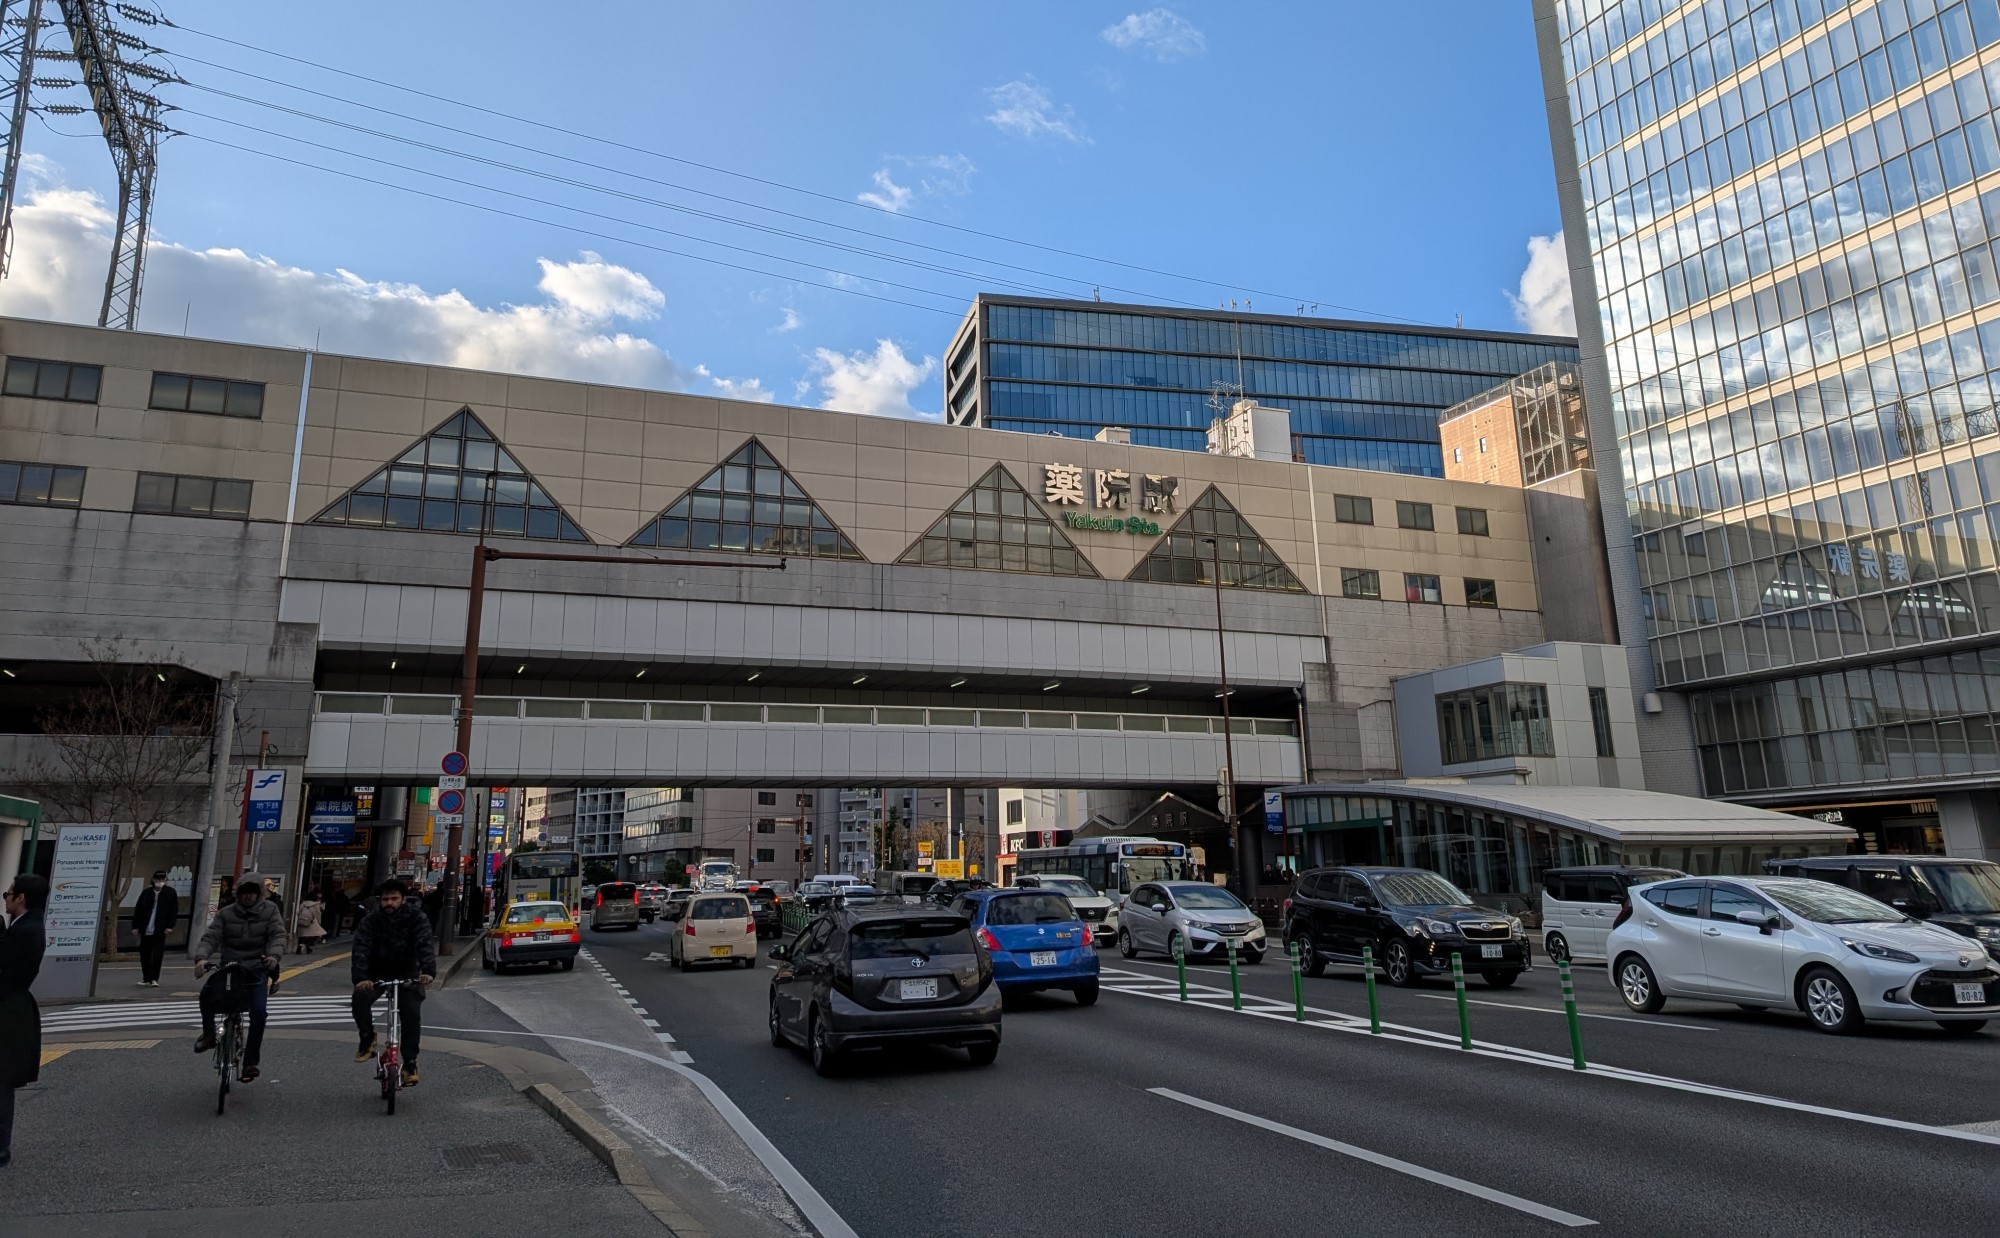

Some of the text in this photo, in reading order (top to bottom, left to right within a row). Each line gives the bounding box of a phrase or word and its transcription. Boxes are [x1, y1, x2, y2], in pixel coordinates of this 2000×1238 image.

[1044, 462, 1180, 515] 薬院駅
[1064, 510, 1163, 536] Yakuin Sta.
[255, 801, 279, 809] 地下鉄
[314, 800, 354, 812] 薬院駅
[1010, 838, 1024, 852] KFC
[1961, 991, 1984, 1001] 80-82
